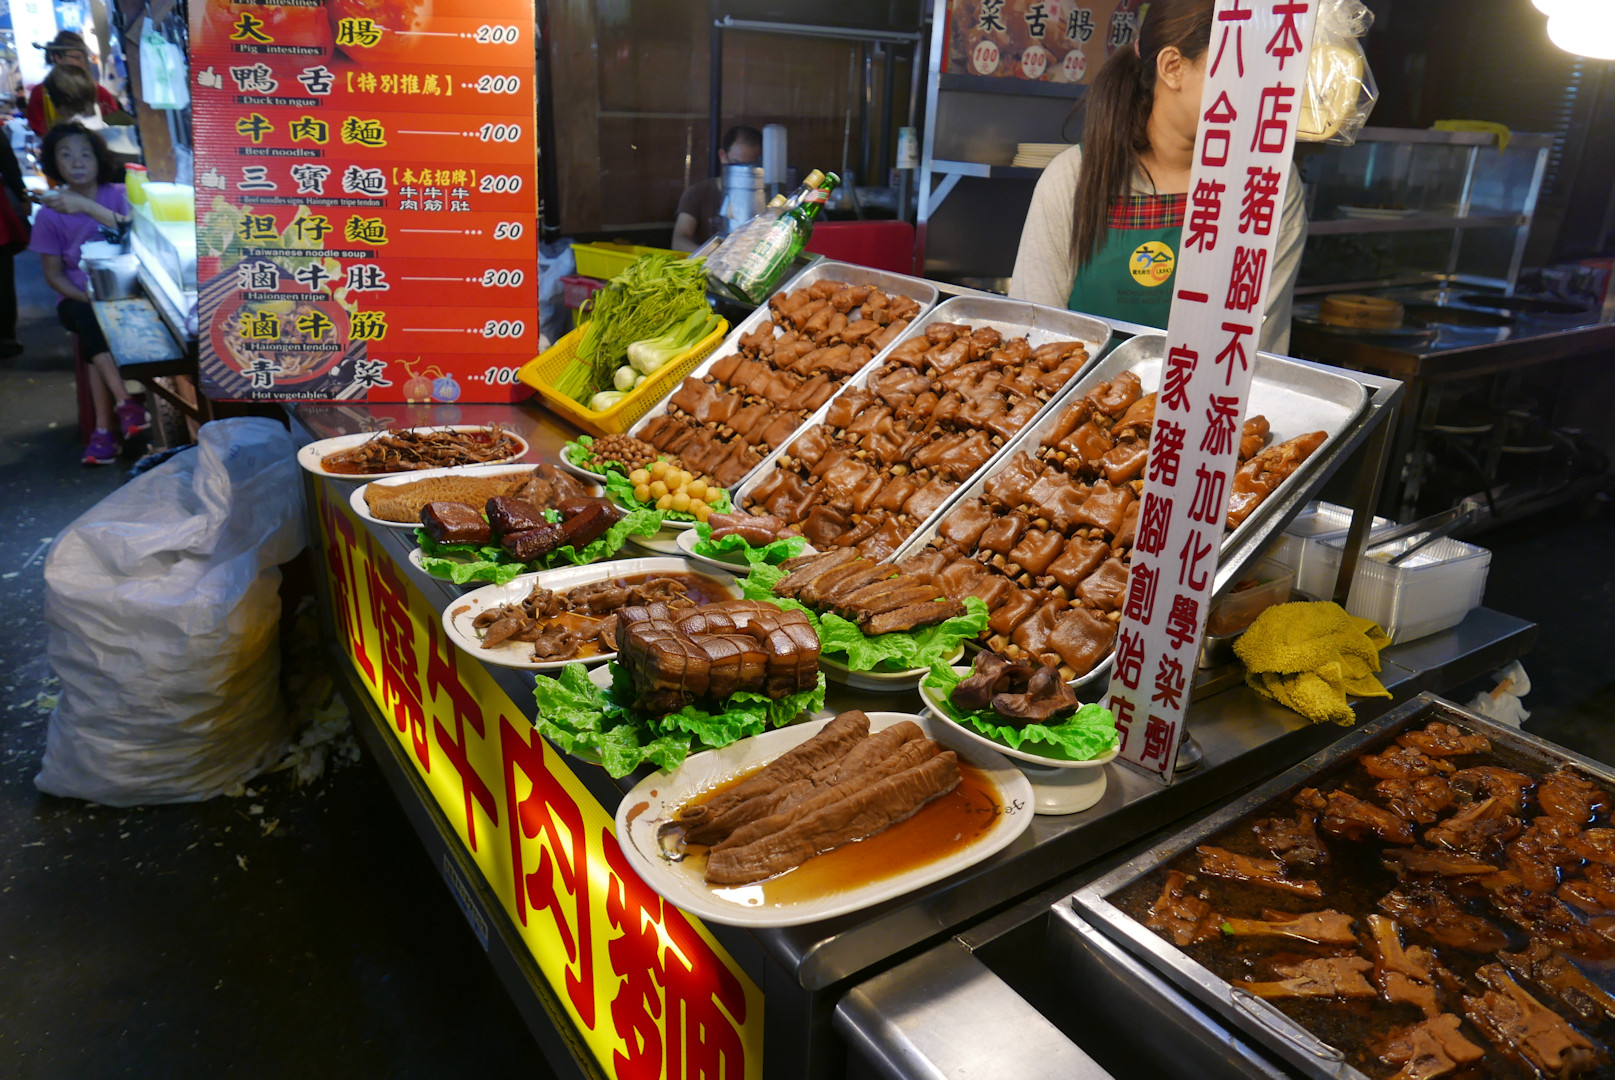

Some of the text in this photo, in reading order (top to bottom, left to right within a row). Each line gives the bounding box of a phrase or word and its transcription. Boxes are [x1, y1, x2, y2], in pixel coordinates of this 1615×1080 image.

[230, 12, 382, 47] 大腸
[1025, 4, 1050, 38] 舌
[1065, 8, 1095, 43] 腸
[475, 25, 520, 45] 200
[239, 44, 320, 56] Pig intestines
[974, 46, 998, 63] 100
[1022, 52, 1046, 67] 200
[1064, 60, 1087, 71] 200
[229, 64, 335, 96] 鴨舌
[477, 75, 520, 94] 200
[243, 96, 273, 105] Duck
[236, 113, 387, 148] 牛肉麵
[479, 123, 521, 142] 100
[245, 146, 316, 158] Beef noodles
[237, 163, 388, 196] 三寶麵
[480, 175, 522, 194] 200
[238, 213, 388, 245] 担仔麵
[493, 221, 523, 241] 50
[248, 248, 367, 260] Taiwanese noodle soup
[238, 261, 389, 292] 滷牛肚
[482, 270, 524, 287] 300
[300, 293, 326, 303] tripe
[239, 310, 389, 341] 滷牛筋
[483, 320, 525, 339] 300
[302, 343, 339, 352] tendon
[241, 357, 394, 389] 青菜
[251, 390, 329, 401] Hot vegetables
